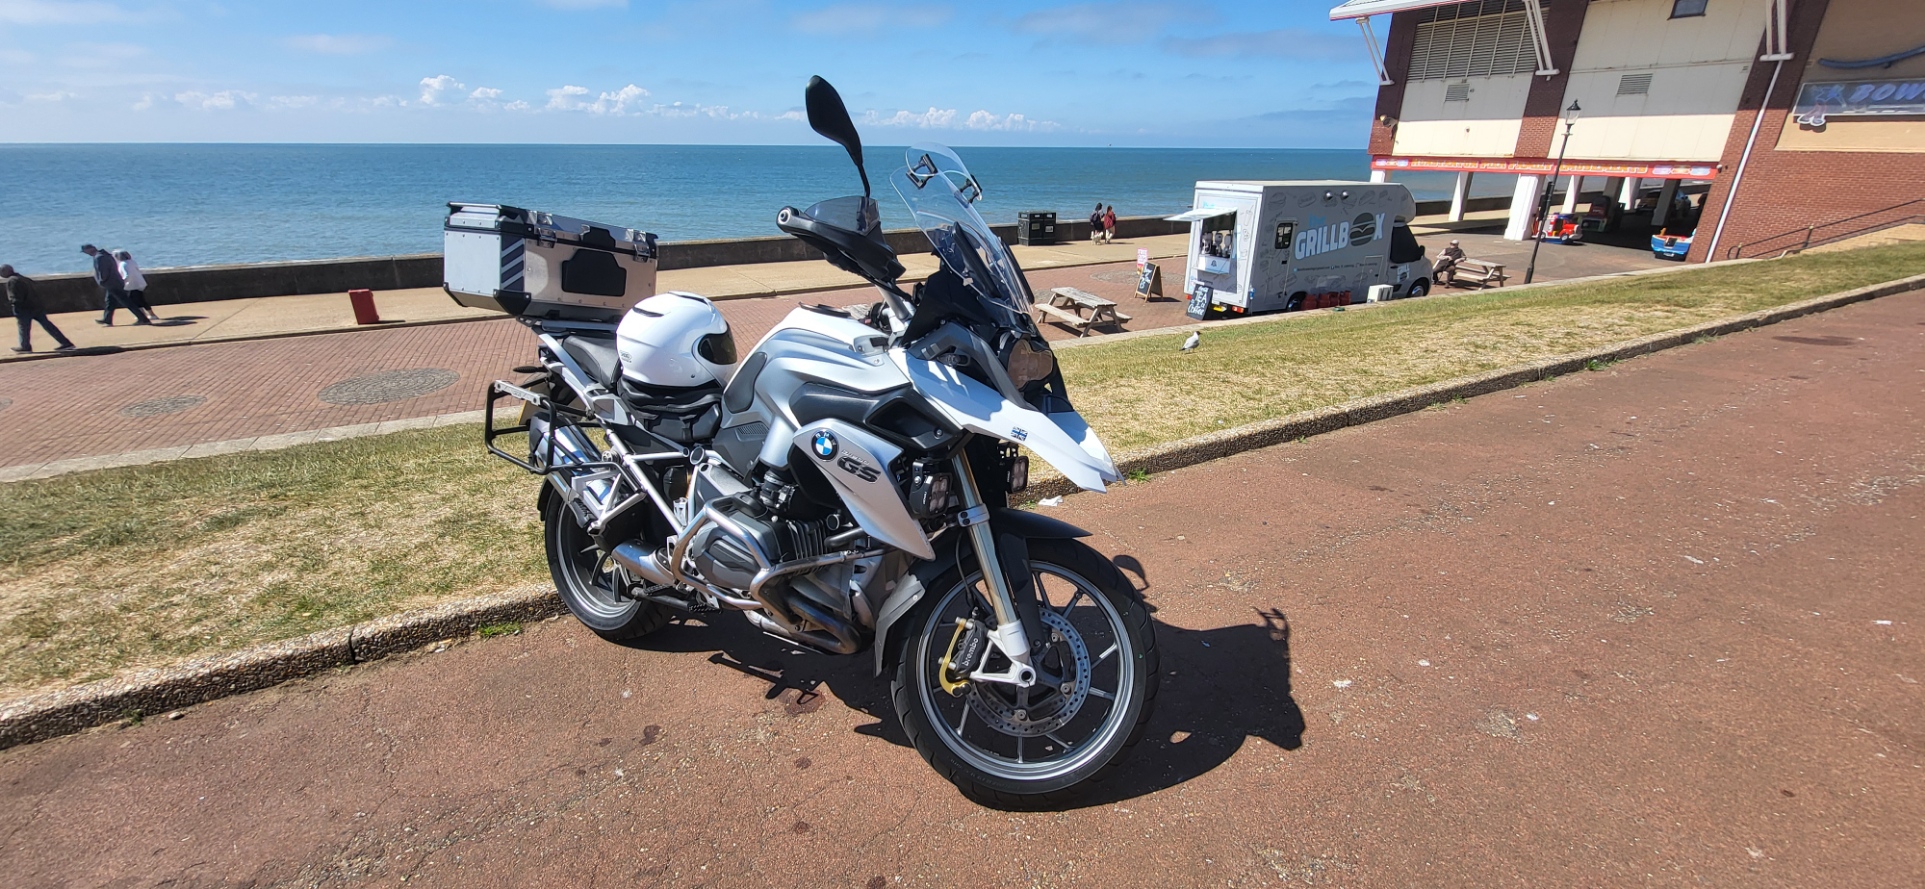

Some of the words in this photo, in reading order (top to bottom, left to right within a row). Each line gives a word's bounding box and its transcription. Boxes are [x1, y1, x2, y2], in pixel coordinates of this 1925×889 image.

[1848, 83, 1925, 103] BOW
[837, 456, 882, 484] GS
[961, 637, 979, 667] brembo
